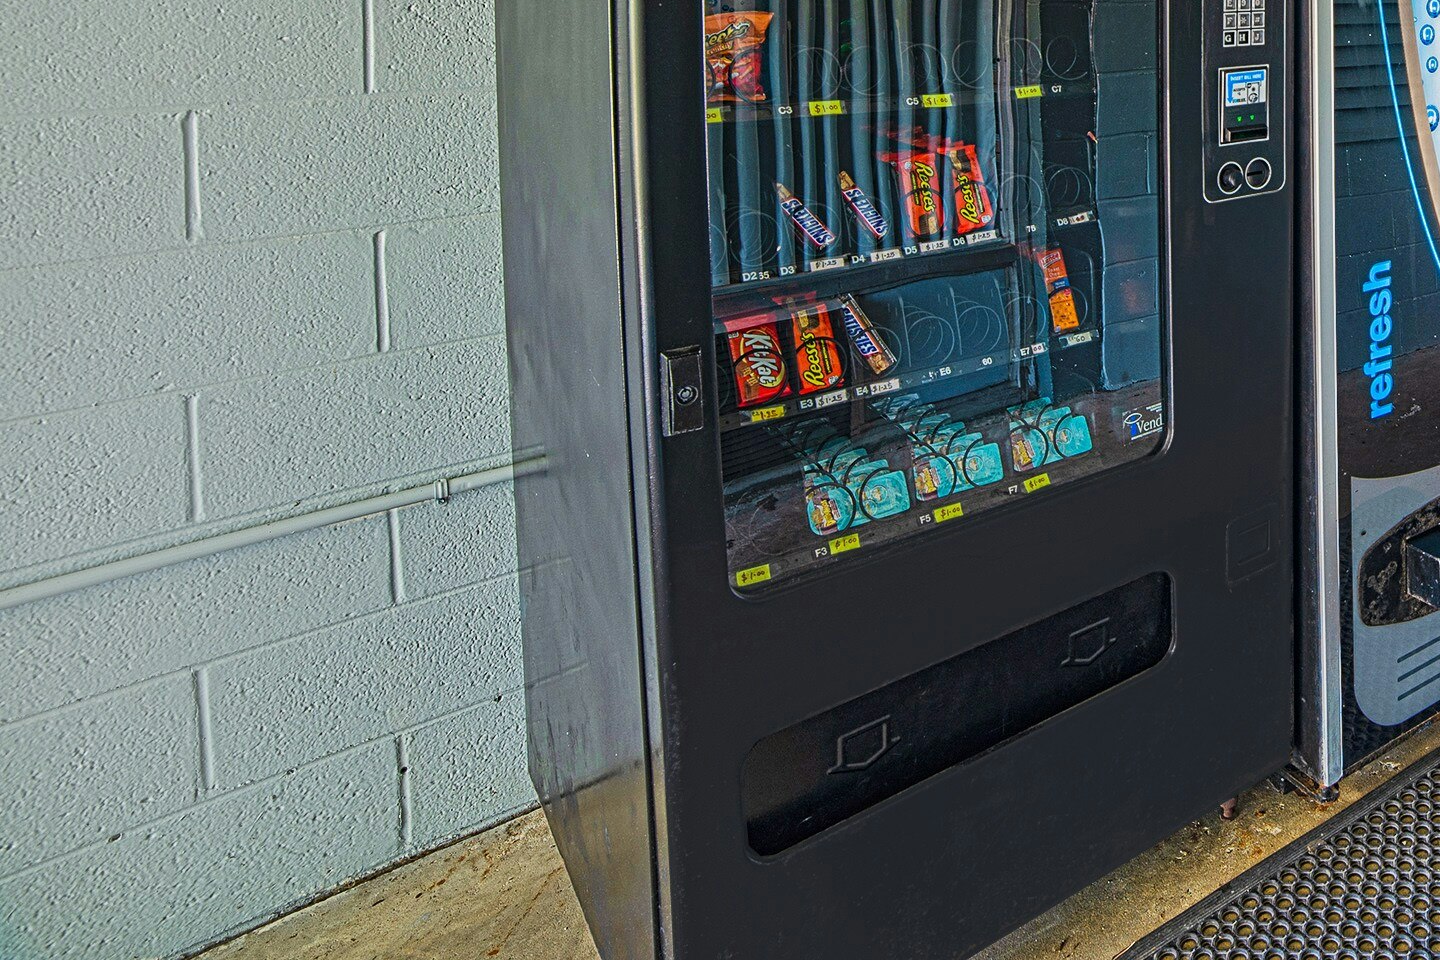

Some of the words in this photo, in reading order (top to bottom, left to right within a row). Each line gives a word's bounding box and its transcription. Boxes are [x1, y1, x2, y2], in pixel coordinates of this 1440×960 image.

[1226, 0, 1233, 7] E
[1224, 34, 1232, 43] G
[1239, 33, 1246, 42] H
[1017, 87, 1038, 97] $1.00
[1051, 85, 1062, 93] C7
[905, 97, 919, 106] C5
[926, 97, 949, 106] $1.00
[777, 106, 793, 115] C3
[814, 104, 839, 113] $1.00
[914, 161, 937, 213] Reese's
[957, 174, 980, 224] Reese's
[1056, 218, 1069, 226] D8
[952, 237, 966, 246] D6
[971, 232, 991, 241] $1.25
[904, 246, 918, 255] D5
[925, 242, 944, 250] $1.25
[851, 255, 866, 264] D4
[874, 252, 895, 260] $1.25
[743, 271, 758, 281] D2
[779, 266, 795, 276] D3
[1363, 260, 1393, 419] refresh
[1020, 347, 1030, 356] E7
[803, 331, 826, 386] Reese's
[940, 367, 951, 376] E6
[856, 386, 868, 395] E4
[872, 382, 893, 392] $1.25
[801, 399, 814, 409] E3
[817, 394, 843, 405] $1.25
[1008, 484, 1018, 495] F7
[940, 506, 960, 519] $1.00
[920, 513, 931, 524] F5
[835, 537, 857, 550] $1.00
[815, 547, 828, 558] F3
[741, 569, 766, 583] $1.00
